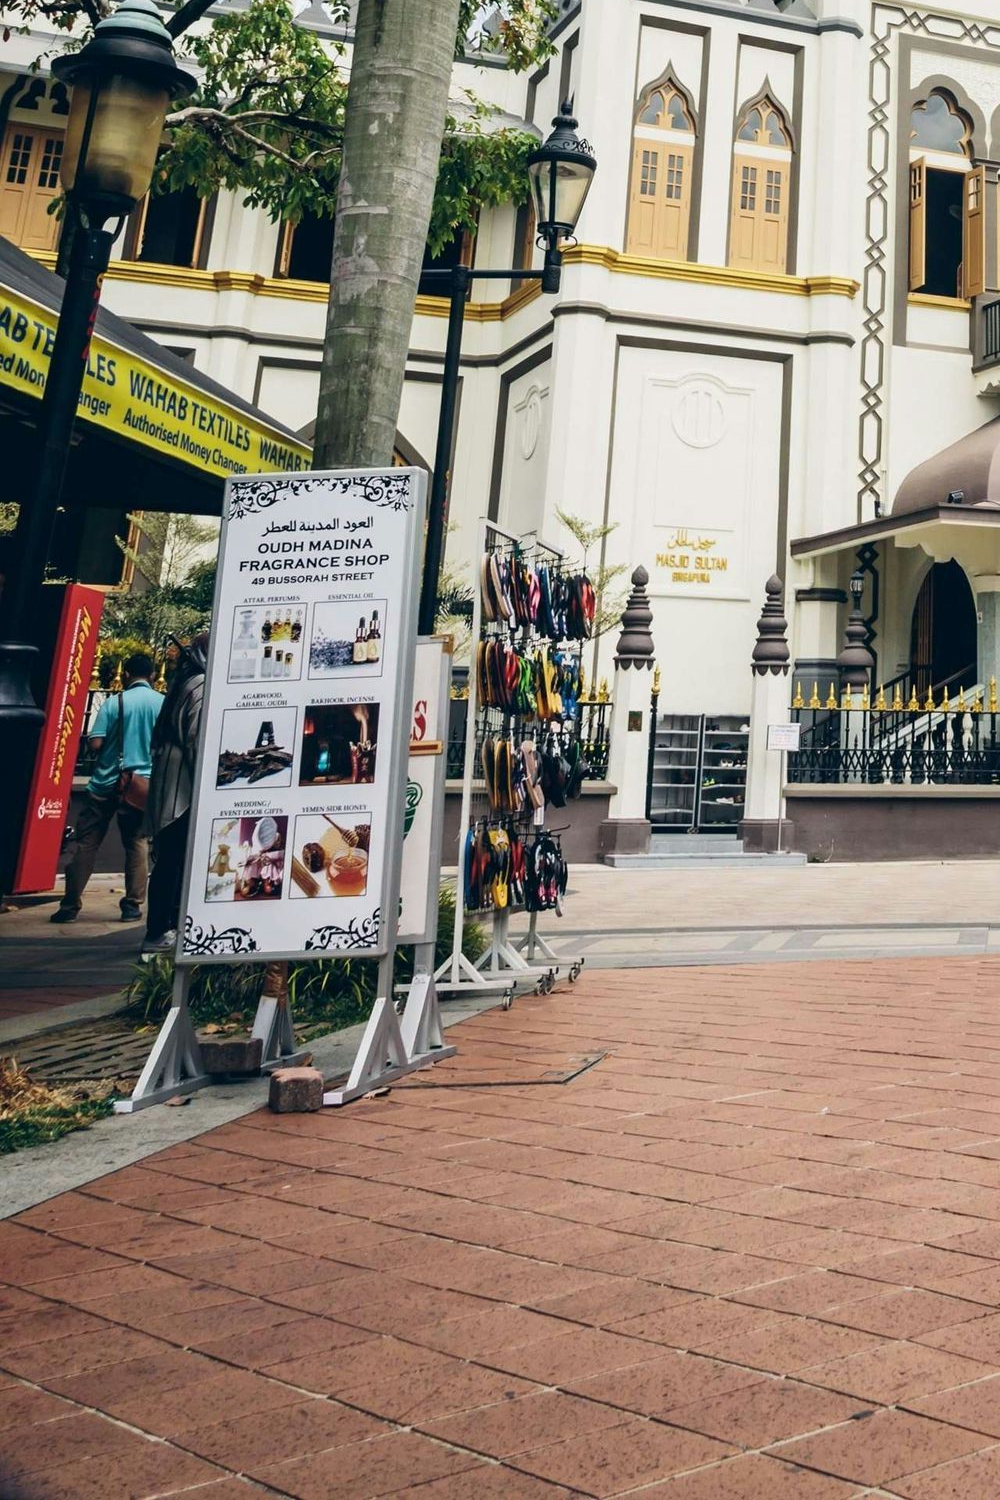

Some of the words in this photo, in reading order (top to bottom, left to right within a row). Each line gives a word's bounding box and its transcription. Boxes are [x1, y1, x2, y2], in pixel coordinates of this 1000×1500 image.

[129, 369, 188, 421] WAHAB
[191, 402, 251, 452] TEXTILES
[123, 408, 179, 447] Authorised
[180, 433, 212, 465] Money
[212, 449, 248, 474] Changer
[257, 541, 304, 554] OUDH
[308, 538, 373, 551] MADINA
[239, 556, 341, 572] FRAGRANCE
[344, 554, 390, 567] SHOP
[694, 556, 728, 571] SULTAN
[251, 577, 265, 585] 49
[267, 574, 329, 585] BUSSORAH
[331, 572, 375, 582] STREET
[267, 595, 301, 603] PERFUMES
[219, 809, 242, 817] EVENT
